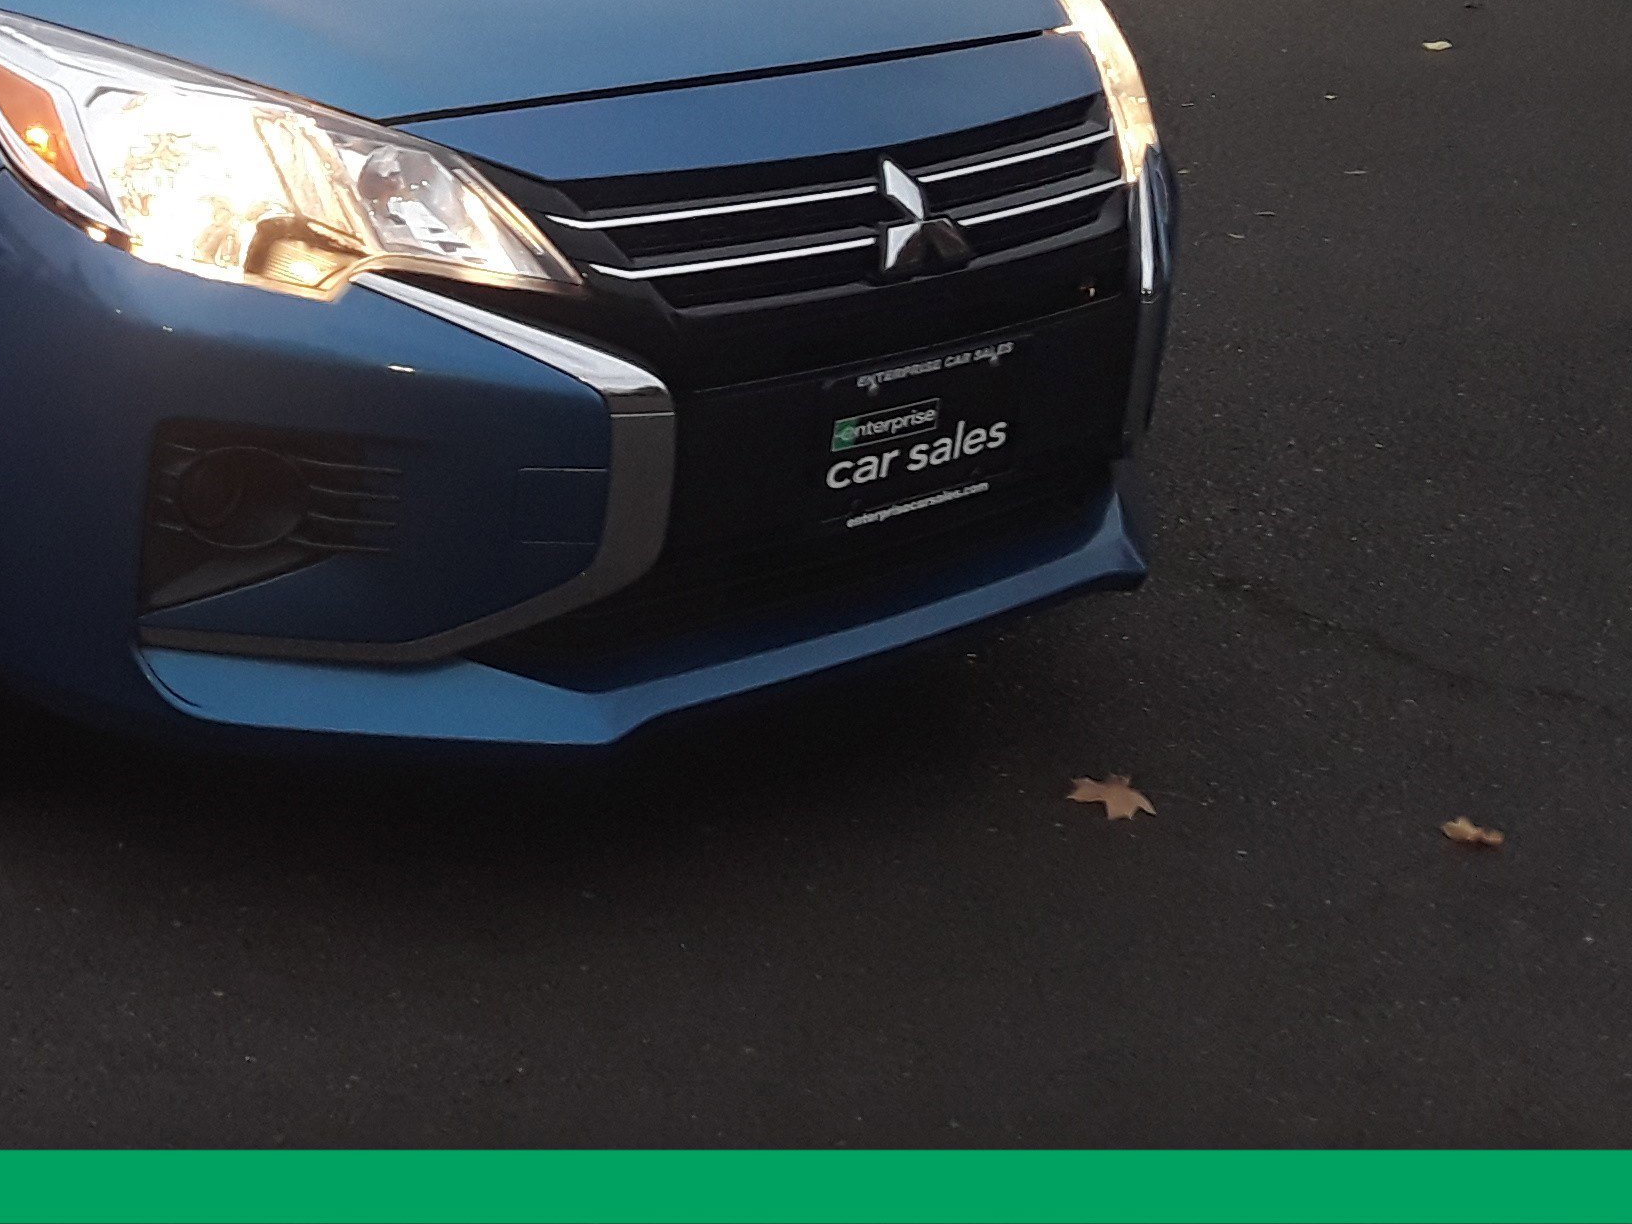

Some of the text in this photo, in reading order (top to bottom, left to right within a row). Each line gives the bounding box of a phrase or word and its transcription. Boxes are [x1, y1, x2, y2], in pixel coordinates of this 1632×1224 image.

[944, 353, 972, 369] CAR
[840, 409, 936, 441] enterprise
[825, 420, 1008, 489] car sales
